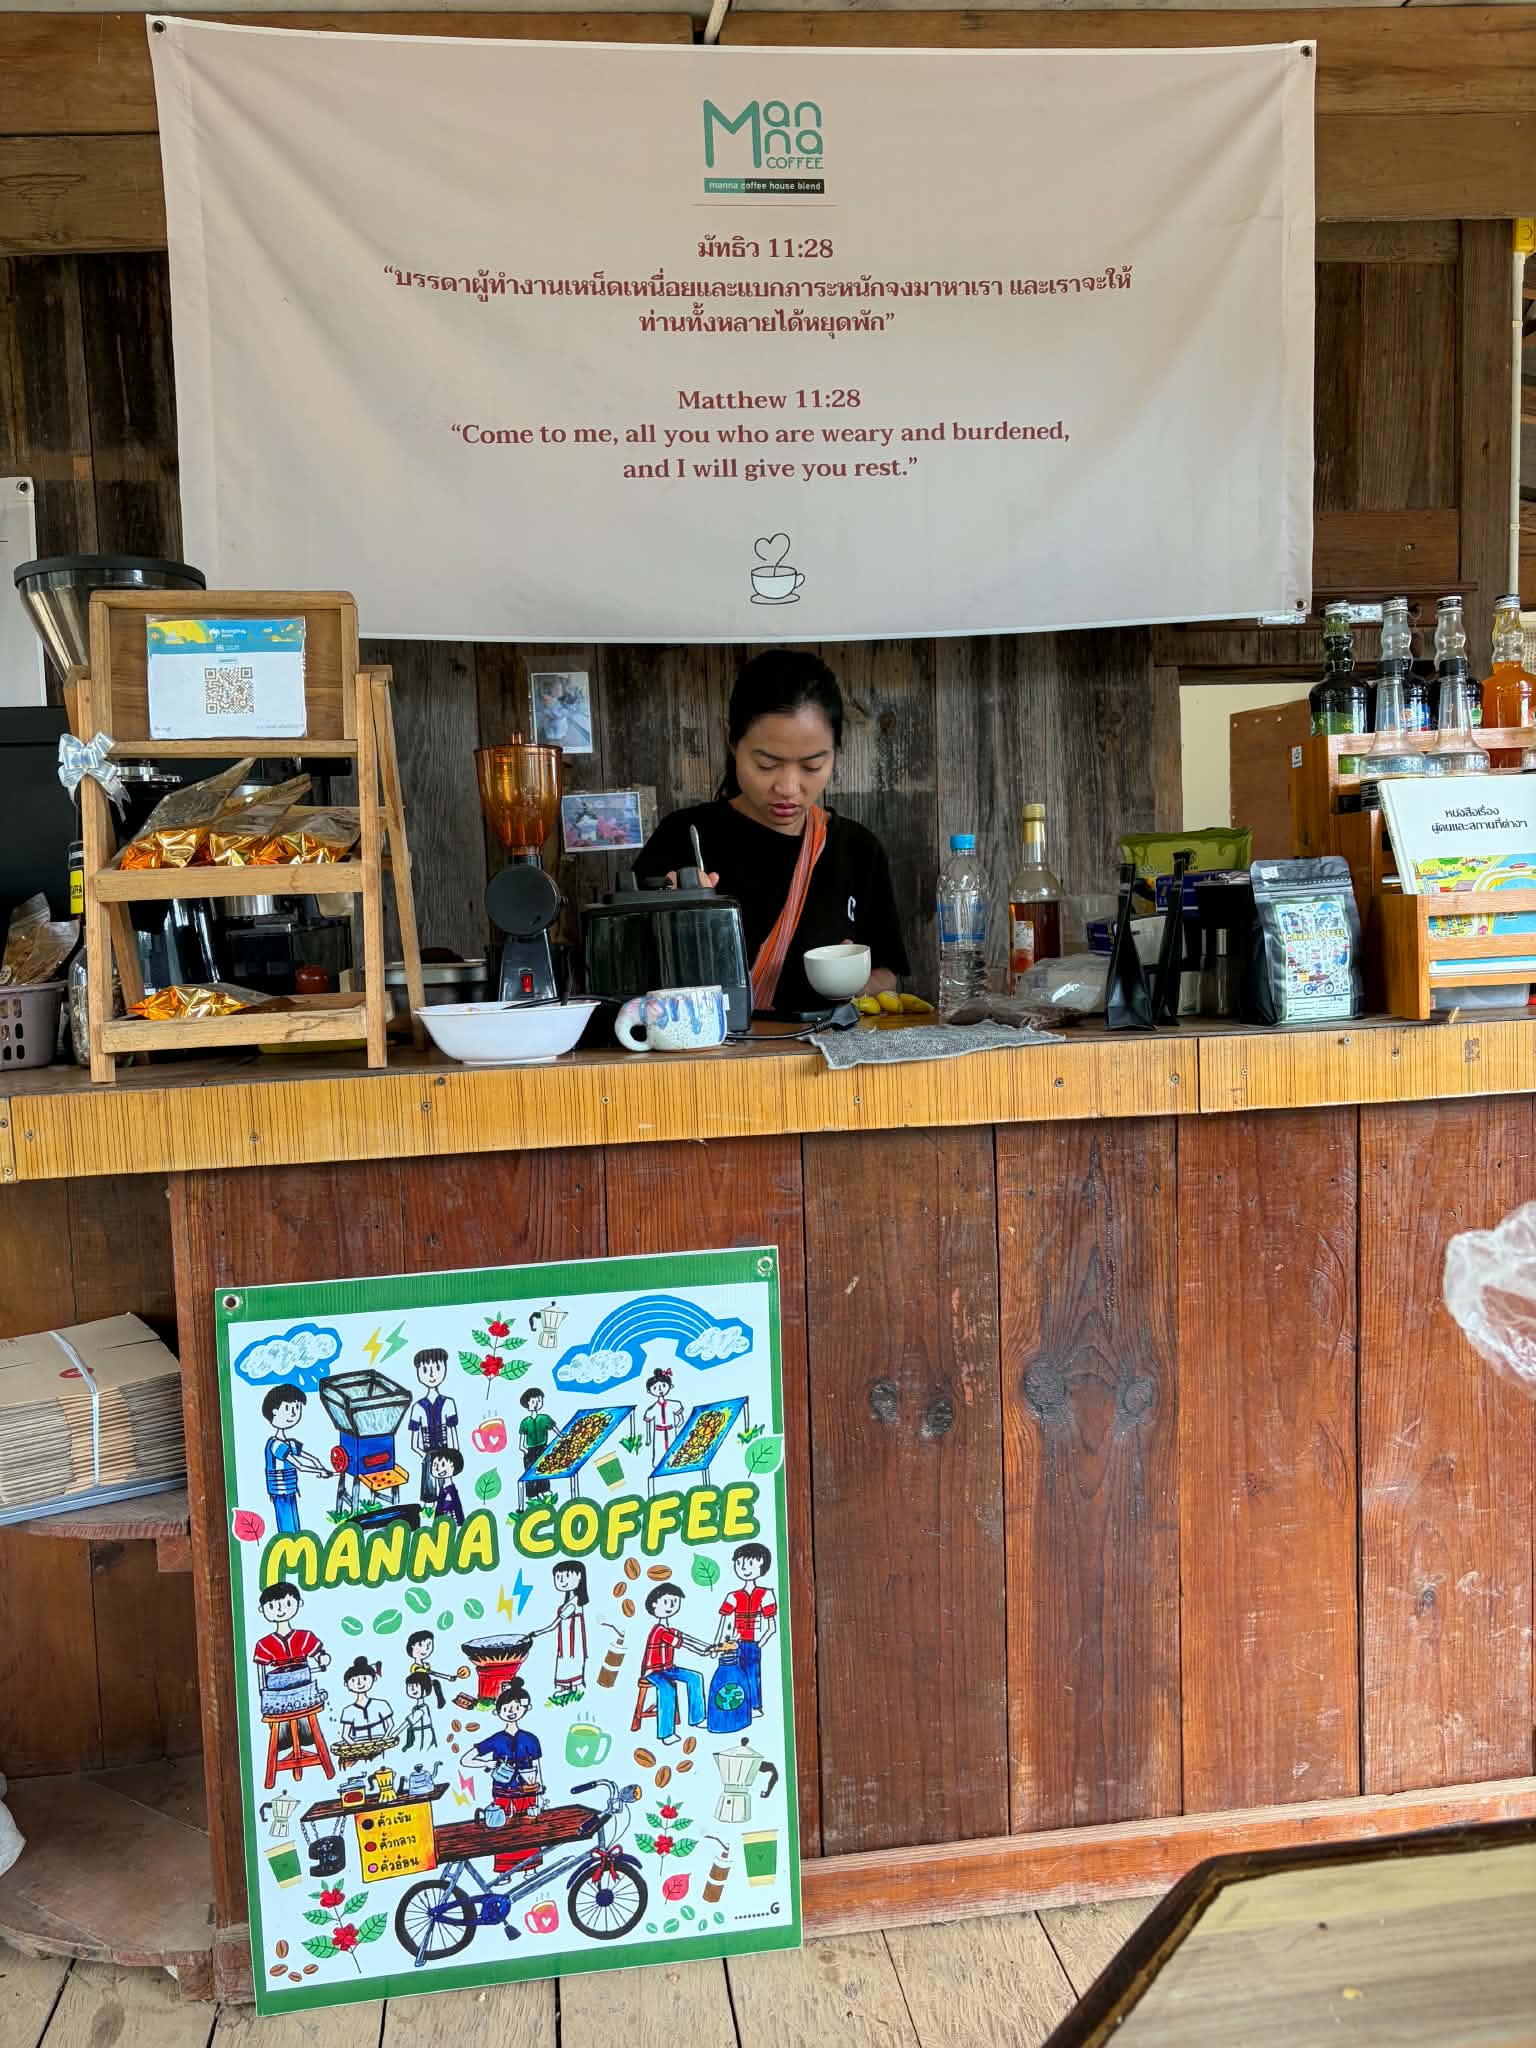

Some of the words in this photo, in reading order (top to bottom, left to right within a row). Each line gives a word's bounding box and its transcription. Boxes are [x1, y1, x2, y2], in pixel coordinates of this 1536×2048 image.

[766, 156, 825, 170] COFFEE
[708, 181, 738, 190] manna
[741, 180, 767, 190] coffee
[769, 181, 795, 190] house
[797, 181, 821, 191] blend
[697, 234, 760, 258] มัทธิว
[769, 238, 834, 258] 11:28
[1009, 264, 1133, 297] และเราจะให้
[677, 389, 788, 410] Matthew
[796, 389, 862, 409] 11:28
[451, 423, 534, 445] “Come
[539, 426, 567, 444] to
[573, 428, 619, 447] me,
[625, 423, 657, 443] all
[664, 429, 711, 448] you
[716, 423, 770, 444] who
[775, 428, 815, 443] are
[821, 427, 895, 447] weary
[900, 421, 947, 442] and
[952, 420, 1070, 444] burdened,
[623, 457, 671, 479] and
[676, 458, 687, 478] I
[692, 458, 738, 478] will
[744, 458, 796, 482] give
[801, 463, 848, 482] you
[854, 456, 918, 477] rest.”
[262, 1511, 498, 1589] MANNA
[517, 1484, 757, 1558] COFFEE
